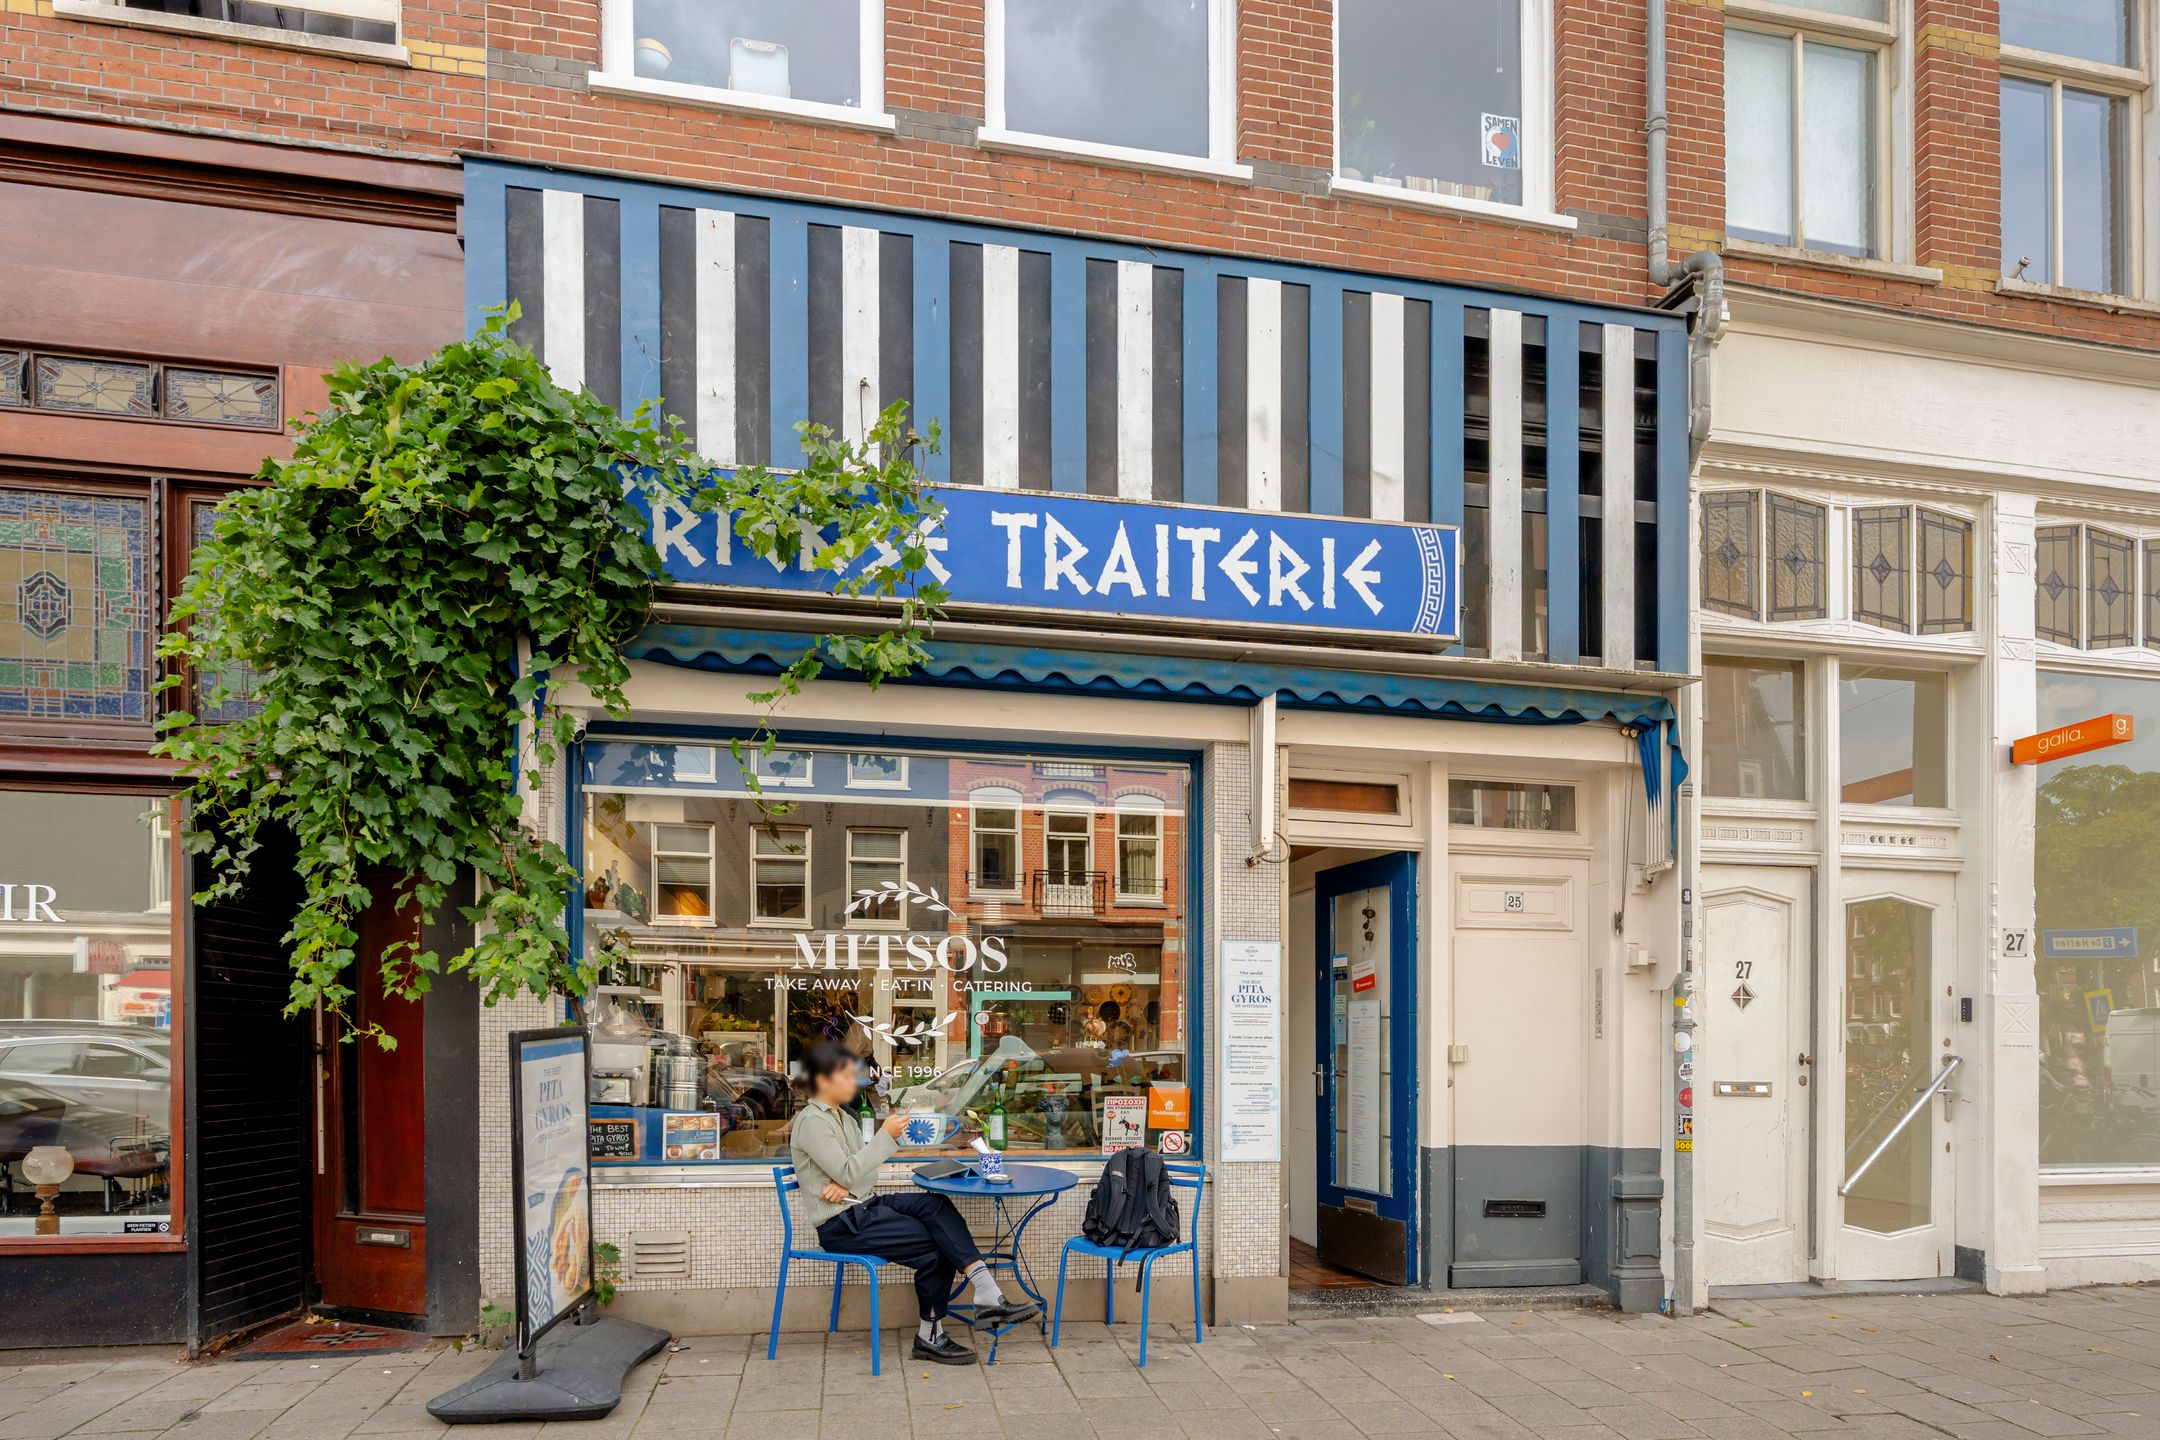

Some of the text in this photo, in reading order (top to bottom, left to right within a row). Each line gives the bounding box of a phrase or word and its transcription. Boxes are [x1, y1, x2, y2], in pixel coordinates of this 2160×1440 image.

[1485, 116, 1517, 135] SAMEN
[1486, 149, 1518, 168] LEVEN
[991, 510, 1384, 616] TRAITERIE
[1508, 896, 1521, 908] 25
[2006, 934, 2025, 951] 27
[791, 933, 1008, 973] MITSOS
[1735, 960, 1752, 979] 27
[764, 978, 1032, 993] TAKE AWAY EAT-IN CATERING
[1239, 985, 1264, 993] PITA
[1231, 994, 1272, 1004] GYROS
[869, 1065, 942, 1078] NCE 1996
[539, 1079, 564, 1103] PITA
[535, 1101, 572, 1131] GYROS
[607, 1124, 629, 1133] BEST
[606, 1133, 630, 1142] GYROS
